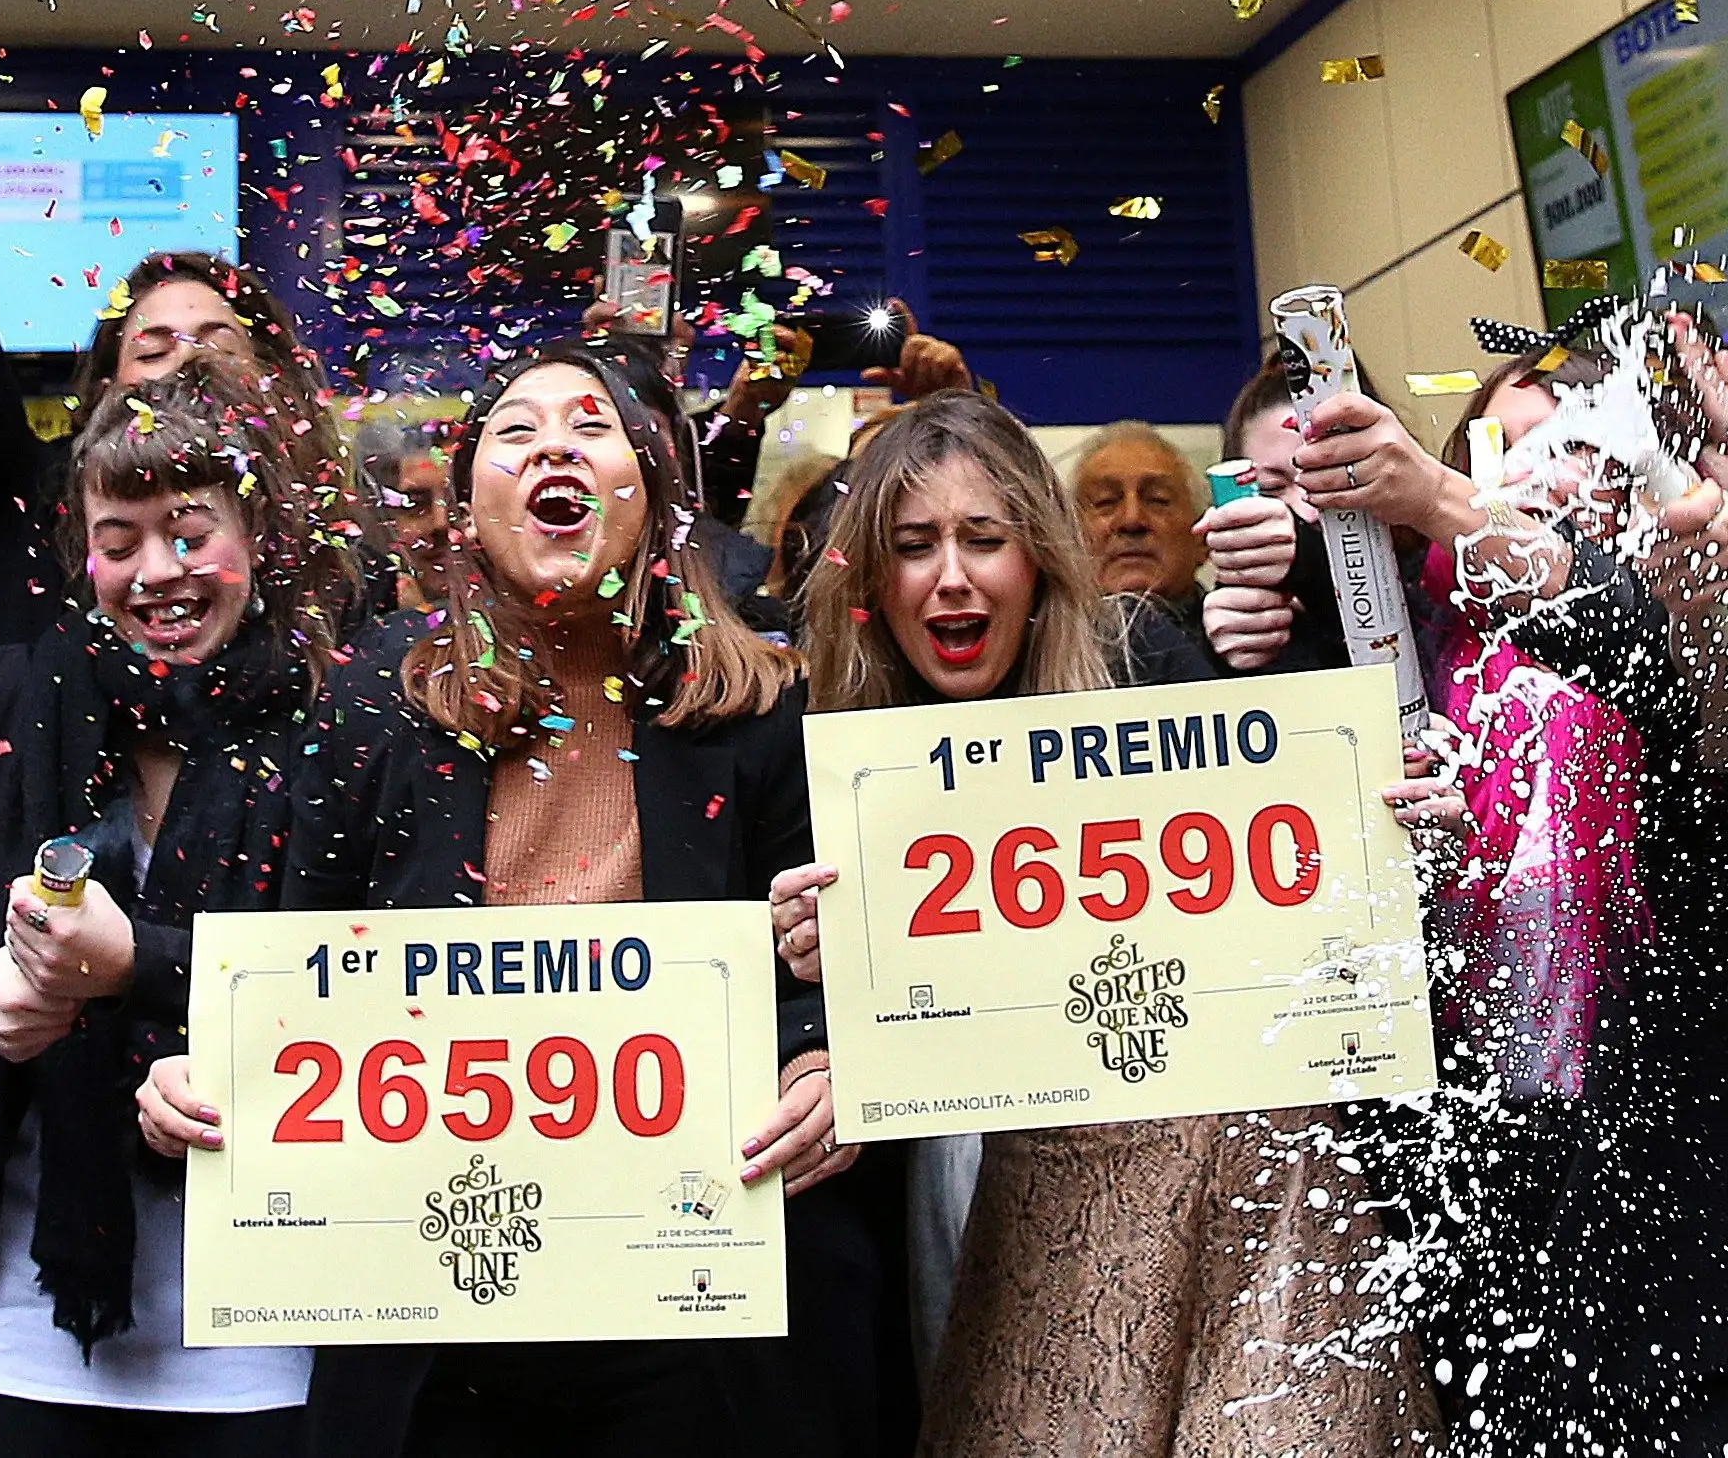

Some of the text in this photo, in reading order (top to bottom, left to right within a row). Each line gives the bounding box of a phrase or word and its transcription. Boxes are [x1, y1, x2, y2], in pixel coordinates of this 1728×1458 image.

[928, 709, 1279, 792] 1er PREMIO
[903, 802, 1323, 939] 26590
[306, 936, 653, 999] 1er PREMIO
[272, 1032, 687, 1145] 26590
[883, 1098, 930, 1118] DOÑA
[933, 1093, 1015, 1114] MANOLITA
[1027, 1087, 1091, 1107] MADRID
[232, 1305, 280, 1324] DOÑA
[283, 1305, 364, 1323] MANOLITA
[376, 1305, 440, 1322] MADRID
